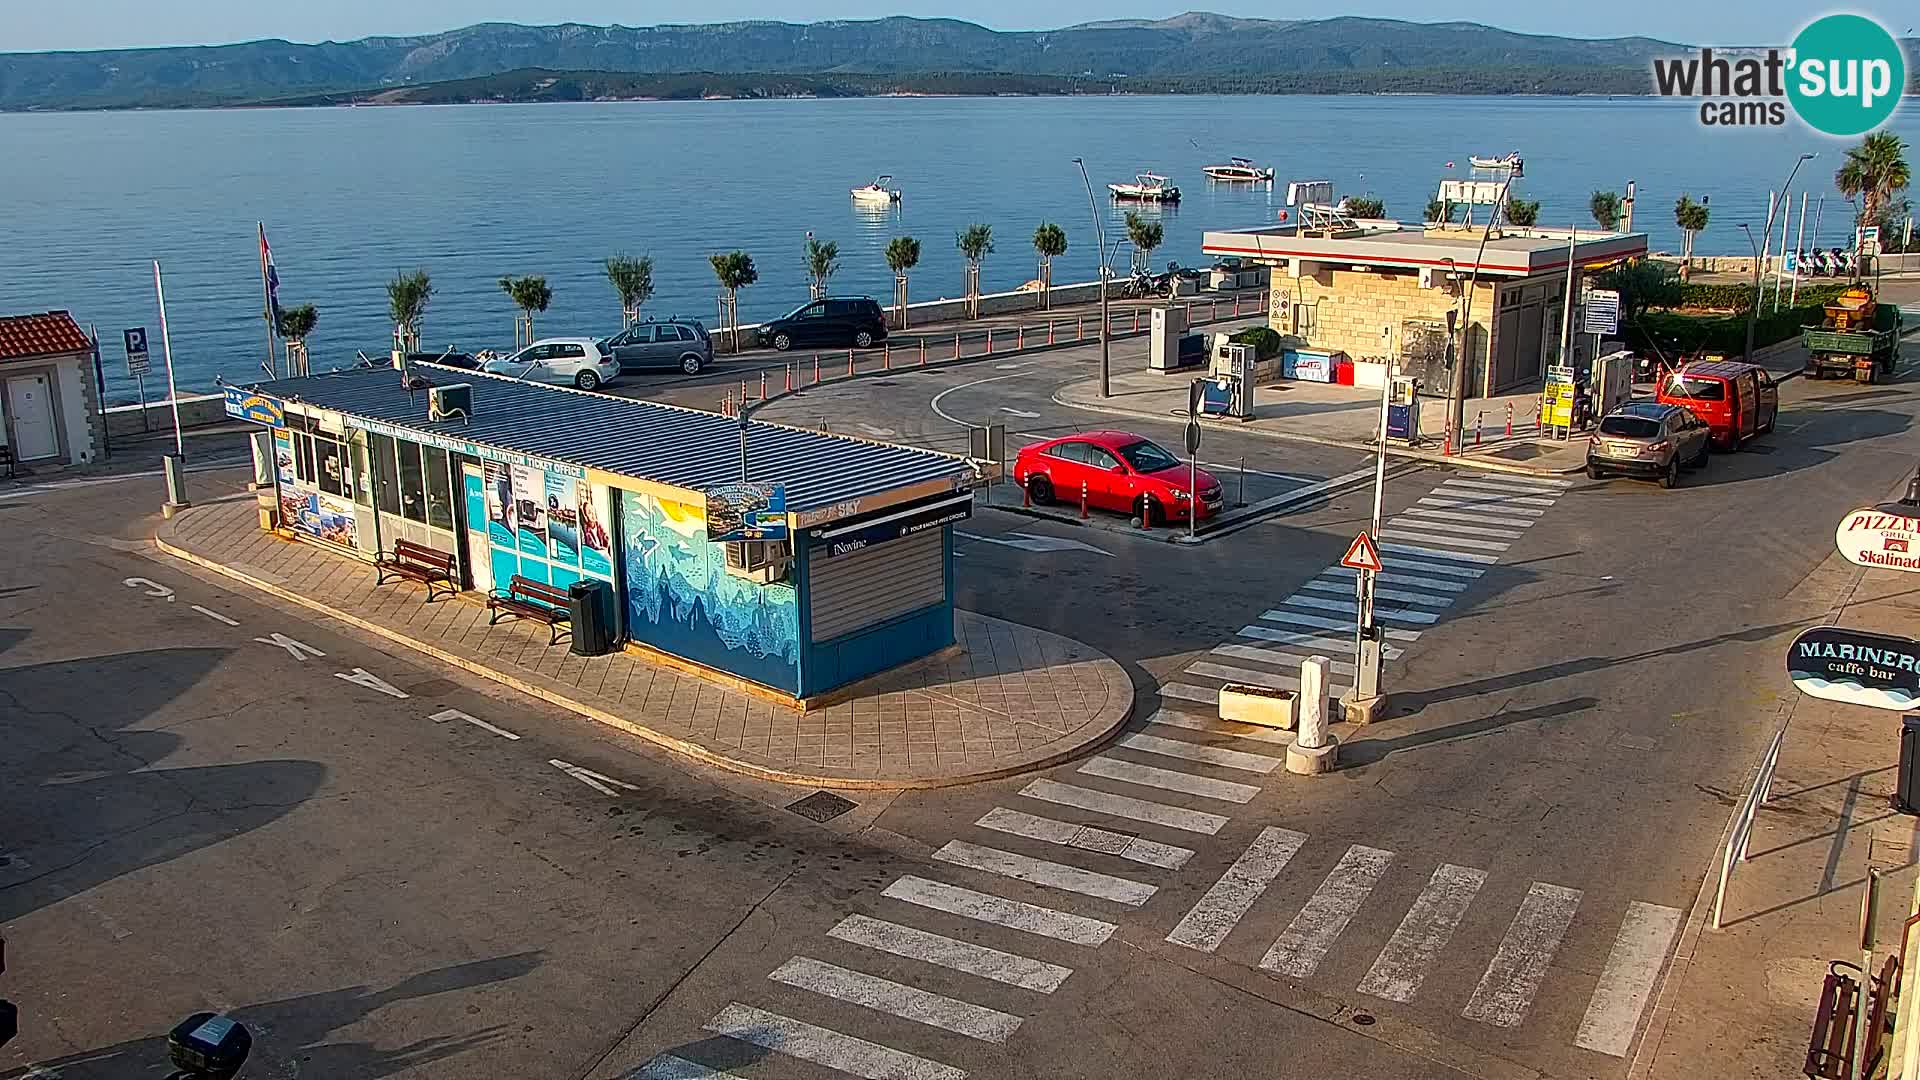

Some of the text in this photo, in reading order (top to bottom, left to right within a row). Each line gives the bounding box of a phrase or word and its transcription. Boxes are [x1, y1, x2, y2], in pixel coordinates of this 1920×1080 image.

[128, 331, 141, 350] P
[435, 436, 466, 451] POSTAJA
[477, 446, 492, 458] BUS
[492, 449, 526, 465] STATION
[528, 457, 554, 472] TICKET
[554, 462, 581, 478] OFFICE
[838, 500, 861, 518] SKY
[1848, 515, 1920, 534] PIZZE
[1880, 530, 1917, 541] GRILL
[1827, 661, 1896, 681] caffe bar
